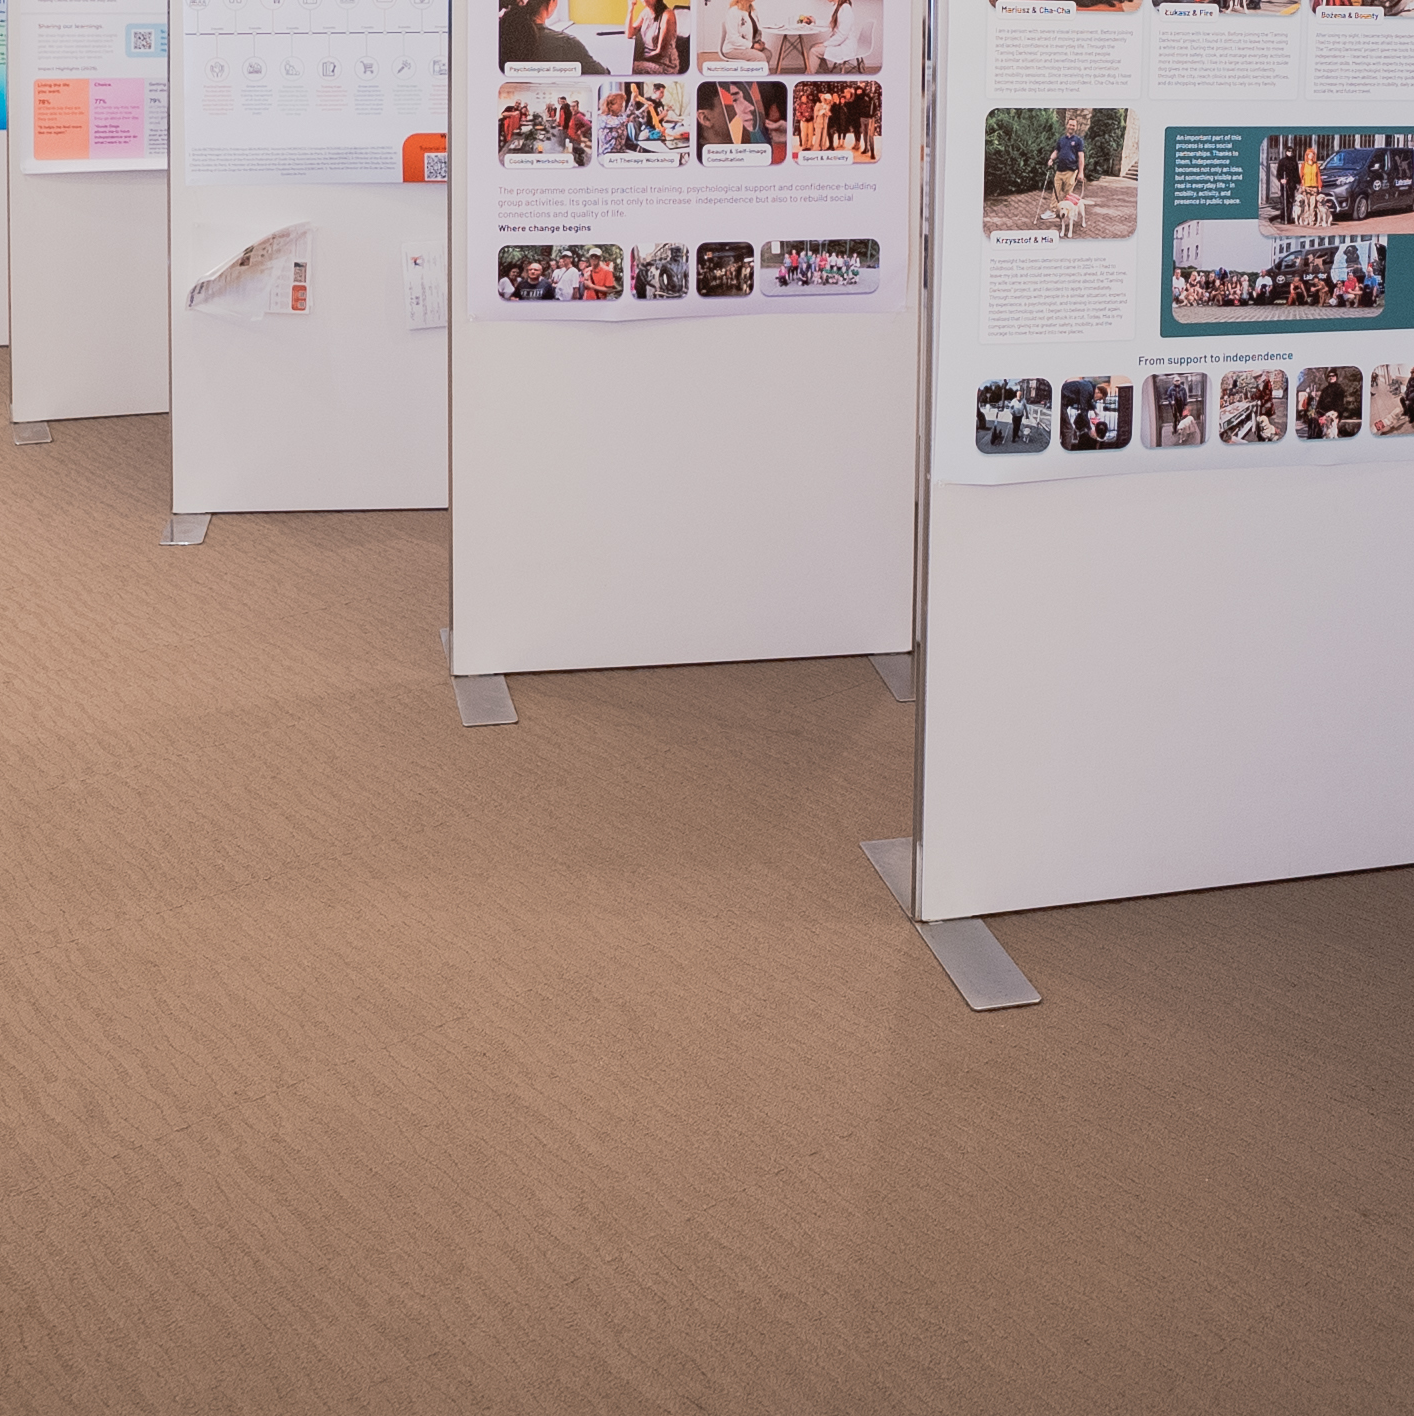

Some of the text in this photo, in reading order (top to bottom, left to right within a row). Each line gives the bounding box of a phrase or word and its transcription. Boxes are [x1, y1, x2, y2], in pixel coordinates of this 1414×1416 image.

[1001, 6, 1071, 15] Mariusz & Cha-Cha
[498, 224, 591, 234] Where change begins
[996, 237, 1032, 245] Krzysztof
[1033, 236, 1039, 244] &
[1138, 351, 1293, 367] From support to independence
